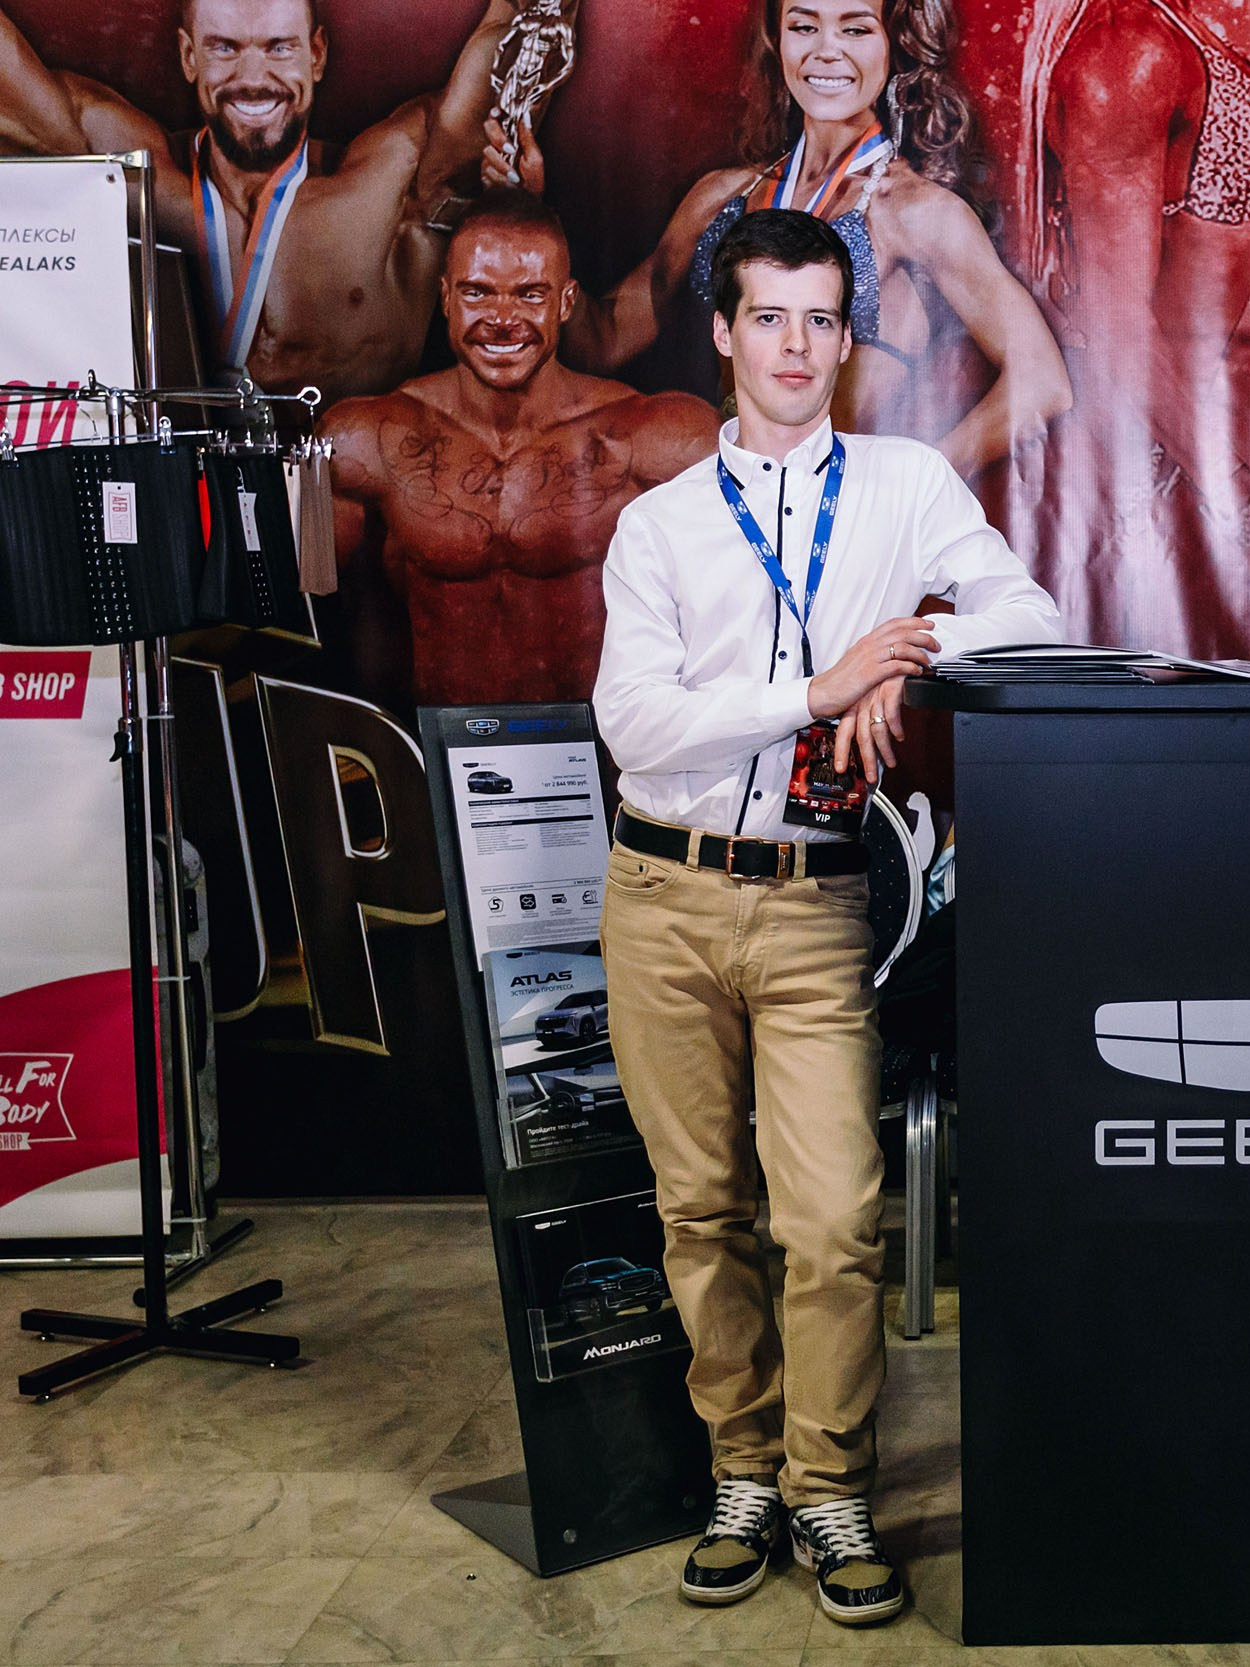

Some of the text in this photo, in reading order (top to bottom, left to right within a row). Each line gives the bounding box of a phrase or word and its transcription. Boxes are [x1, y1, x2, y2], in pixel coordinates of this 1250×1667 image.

[0, 256, 76, 271] EALAKS
[112, 495, 127, 513] AFB
[728, 503, 742, 521] GEELY
[829, 496, 838, 516] GEELY
[751, 542, 767, 564] GEELY
[820, 541, 828, 564] GEELY
[11, 672, 75, 700] SHOP
[815, 812, 831, 823] VIP
[510, 970, 573, 987] ATLAS
[15, 1060, 57, 1094] FOR
[583, 1333, 662, 1361] MONJARO
